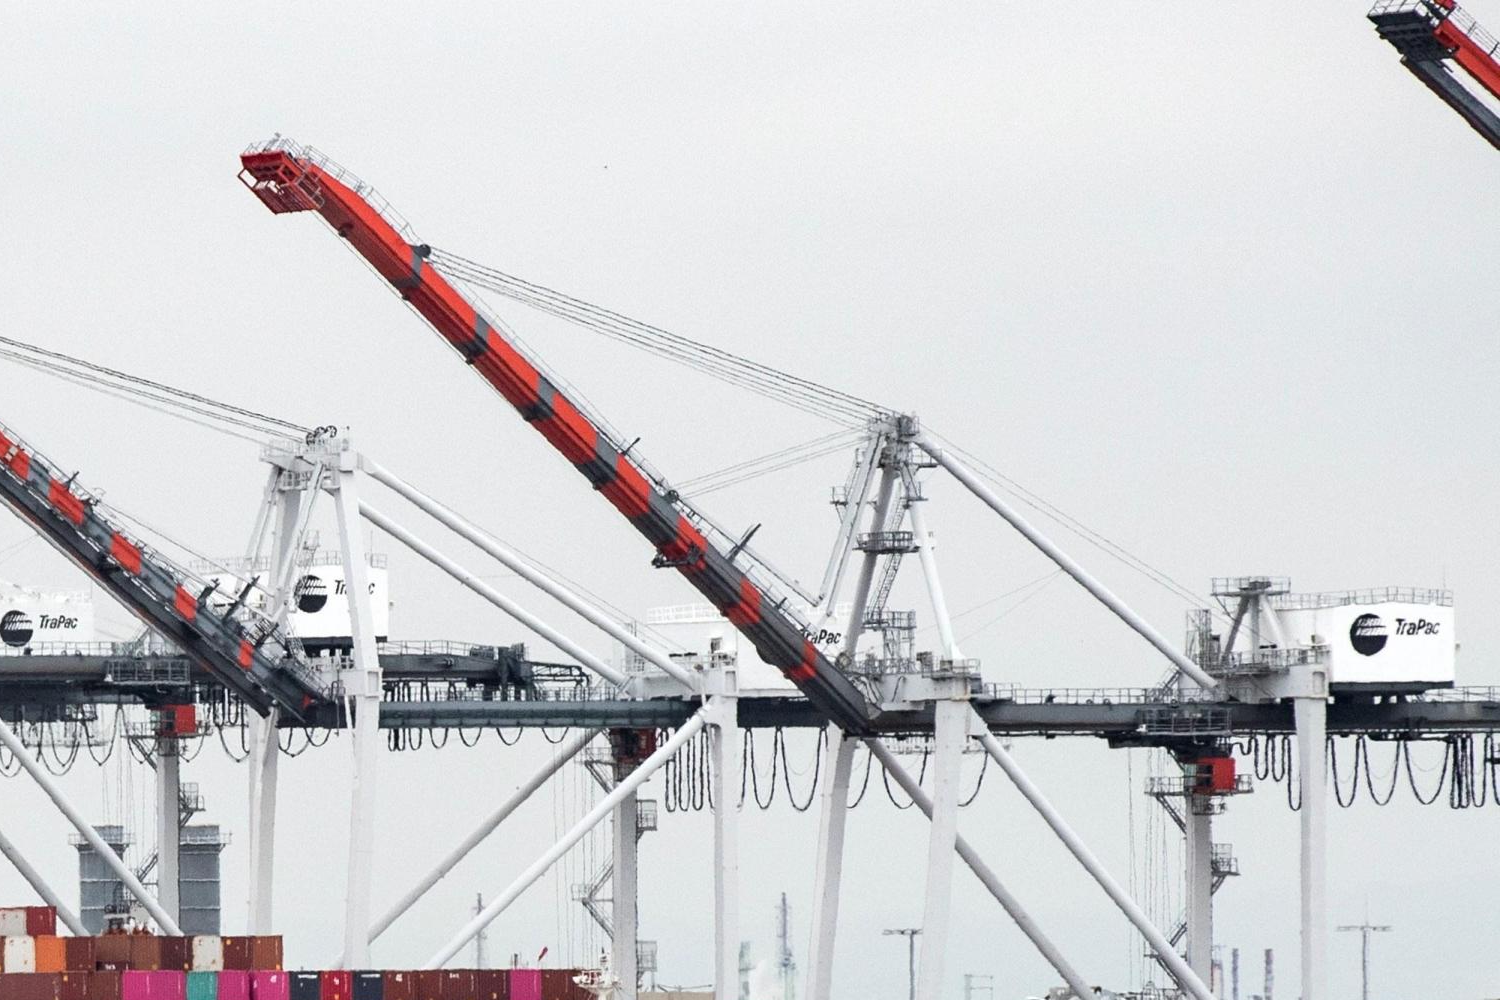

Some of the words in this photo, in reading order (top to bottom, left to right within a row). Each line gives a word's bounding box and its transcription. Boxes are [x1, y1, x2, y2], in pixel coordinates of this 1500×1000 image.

[335, 579, 375, 595] Trc
[39, 614, 78, 630] TraPac
[1395, 618, 1440, 635] TraPac
